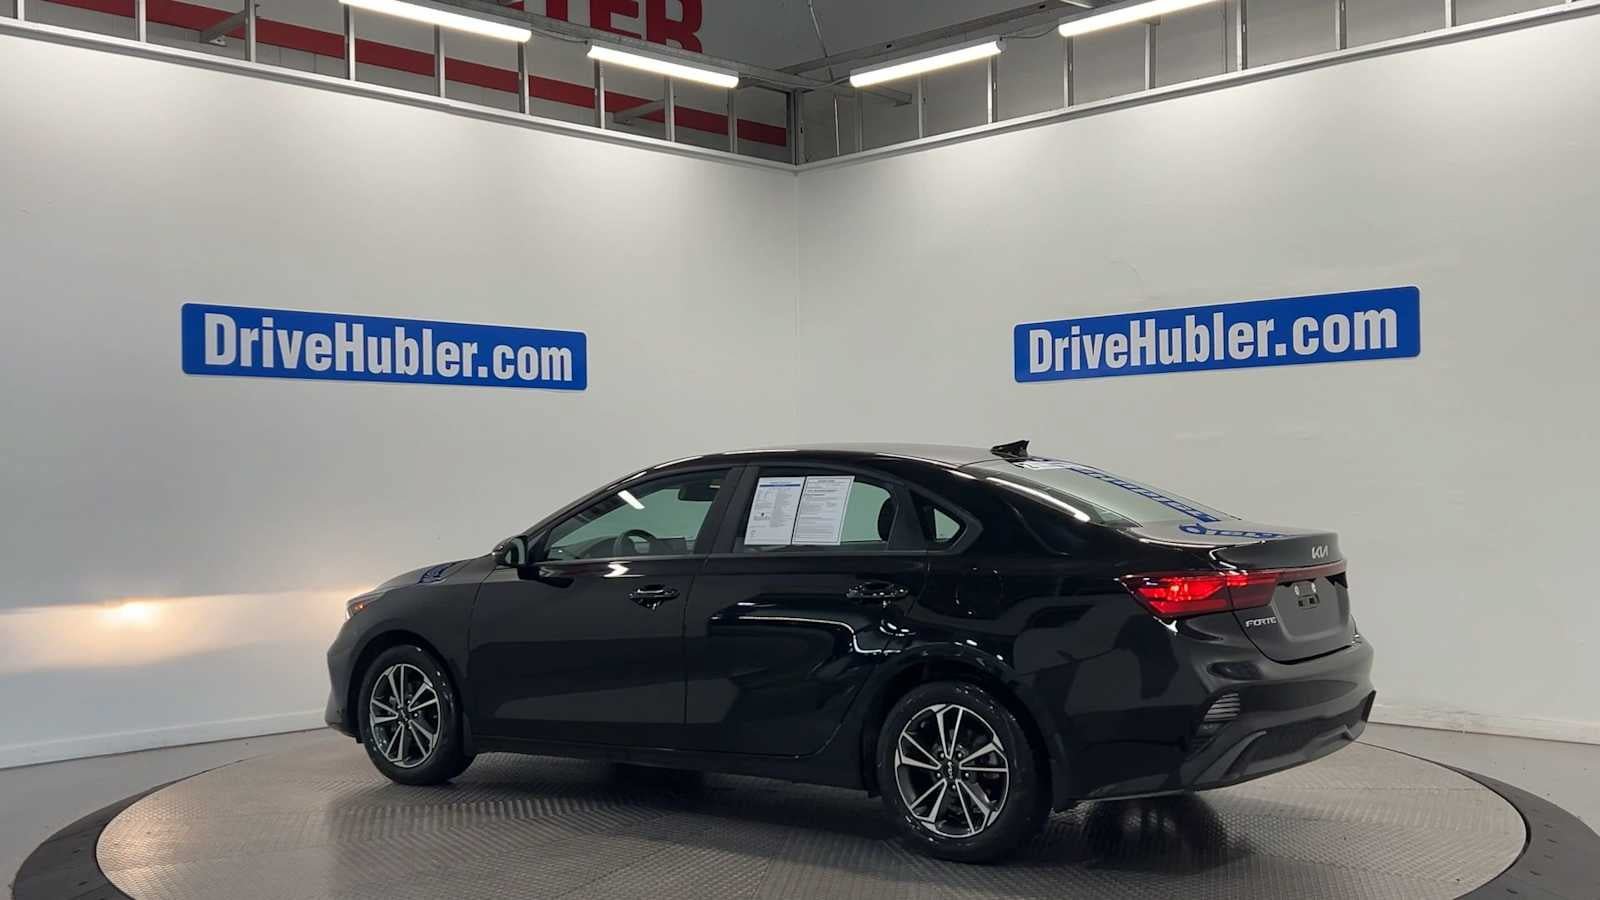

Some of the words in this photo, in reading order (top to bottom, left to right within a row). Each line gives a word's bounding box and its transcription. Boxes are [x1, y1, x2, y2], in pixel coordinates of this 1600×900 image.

[204, 312, 573, 381] DriveHubler.com
[1029, 308, 1398, 374] DriveHubler.com
[1311, 544, 1329, 560] KIA
[1245, 616, 1277, 628] FORTE
